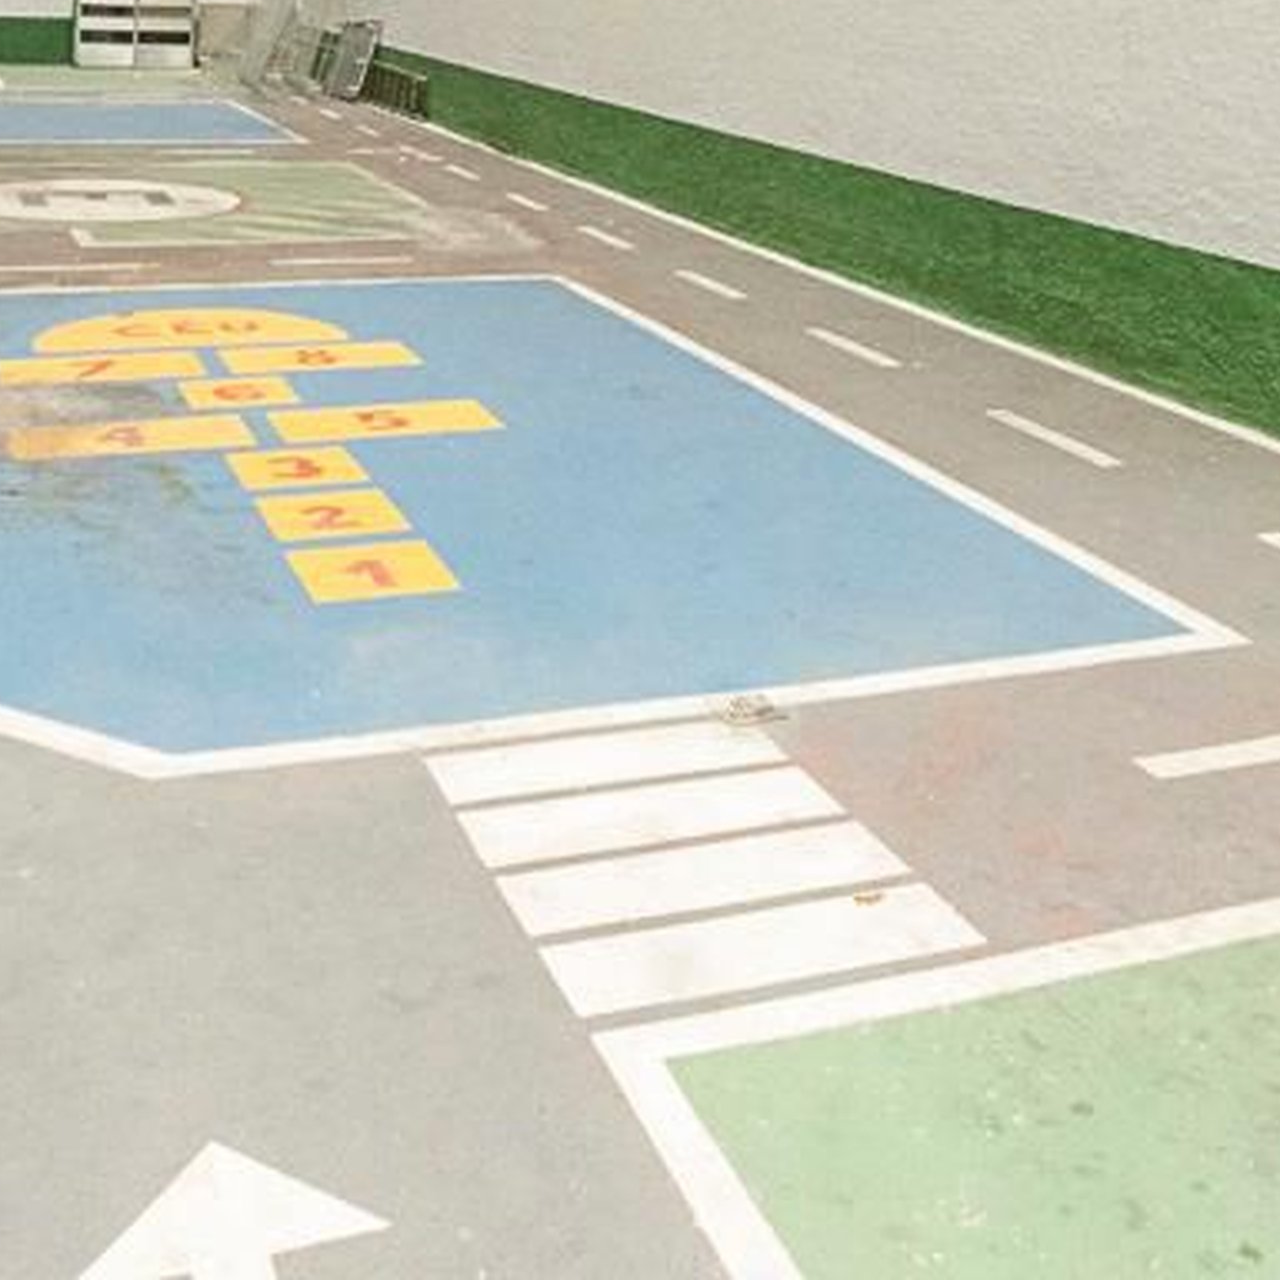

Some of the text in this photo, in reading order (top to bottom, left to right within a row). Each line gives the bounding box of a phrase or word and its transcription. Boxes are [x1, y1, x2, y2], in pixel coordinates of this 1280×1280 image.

[295, 349, 337, 365] 8
[69, 360, 114, 377] 7
[211, 383, 265, 401] 6
[355, 410, 410, 430] 5
[101, 426, 144, 447] 4
[267, 455, 323, 478] 3
[302, 505, 362, 530] 2
[345, 559, 397, 587] 1
